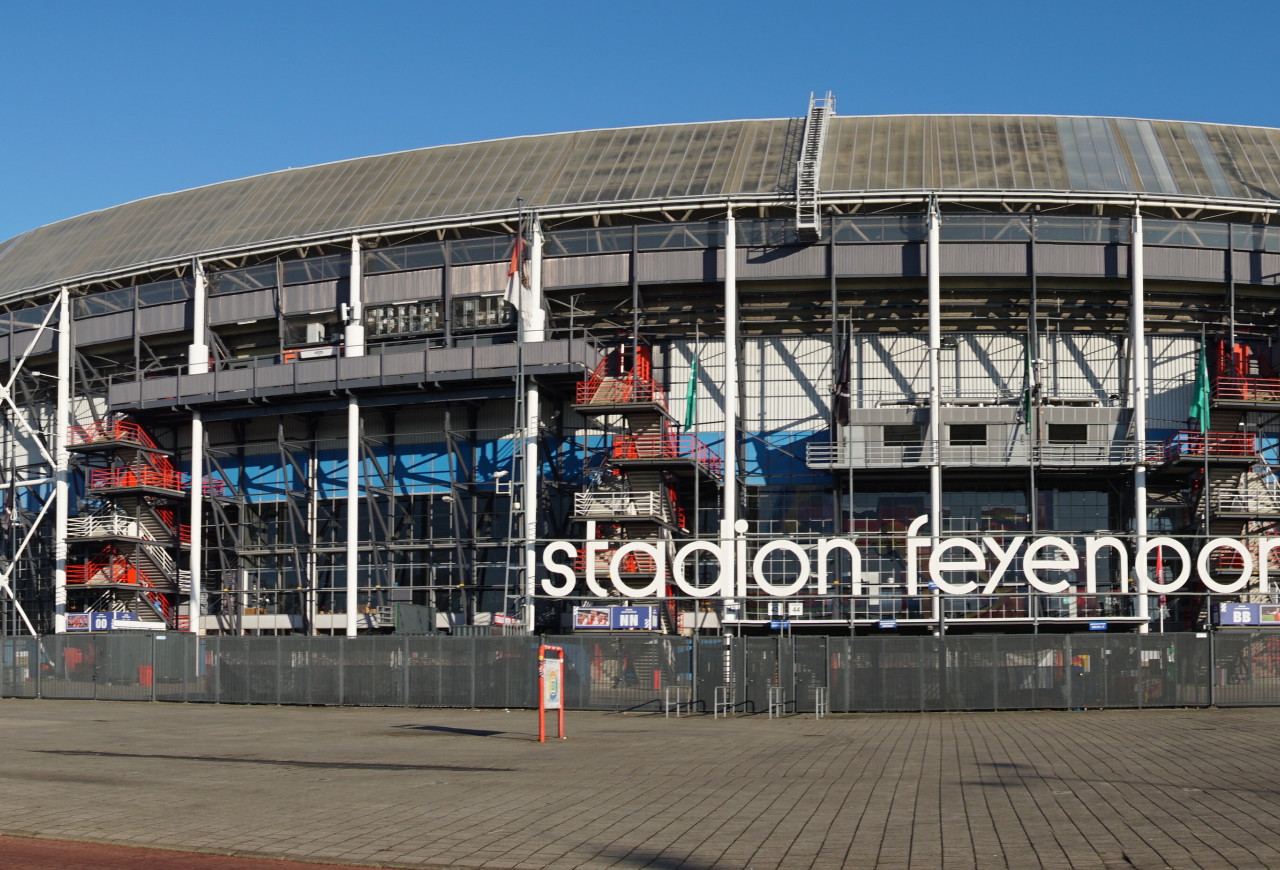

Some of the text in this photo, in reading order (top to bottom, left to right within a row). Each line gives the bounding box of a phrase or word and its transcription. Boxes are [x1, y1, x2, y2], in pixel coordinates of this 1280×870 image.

[541, 519, 861, 598] stadion
[620, 614, 639, 627] NN
[1233, 610, 1252, 623] BB
